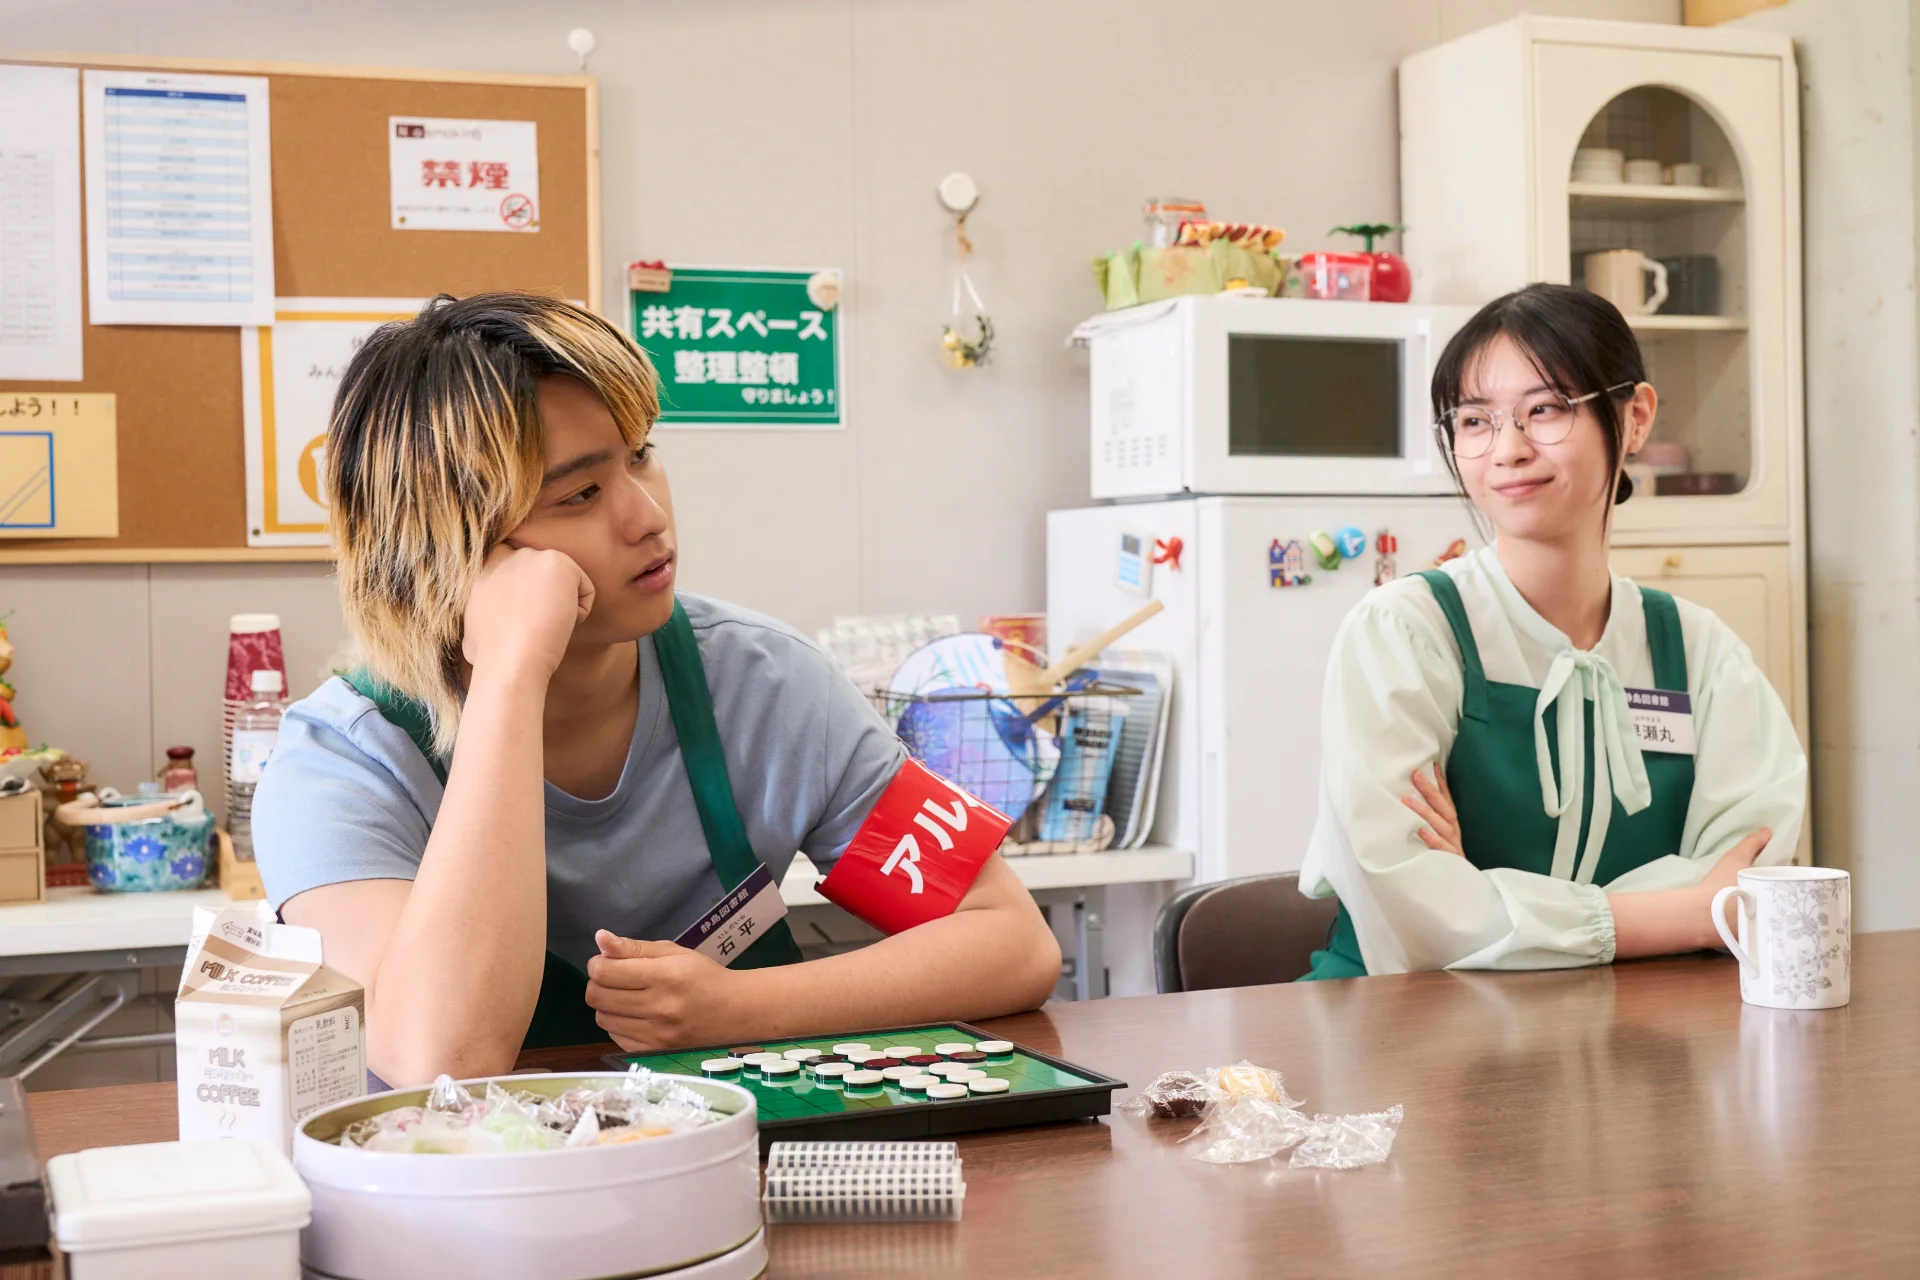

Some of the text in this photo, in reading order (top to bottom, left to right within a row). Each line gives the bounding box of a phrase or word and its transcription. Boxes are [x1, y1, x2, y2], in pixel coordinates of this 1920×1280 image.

[422, 160, 509, 189] 禁煙
[641, 304, 828, 341] 共有スペース
[674, 350, 799, 385] 整理整頓
[880, 779, 977, 894] アル
[200, 960, 297, 986] MILK COFFEE
[209, 1047, 246, 1068] MILK
[196, 1083, 260, 1107] COFFEE
